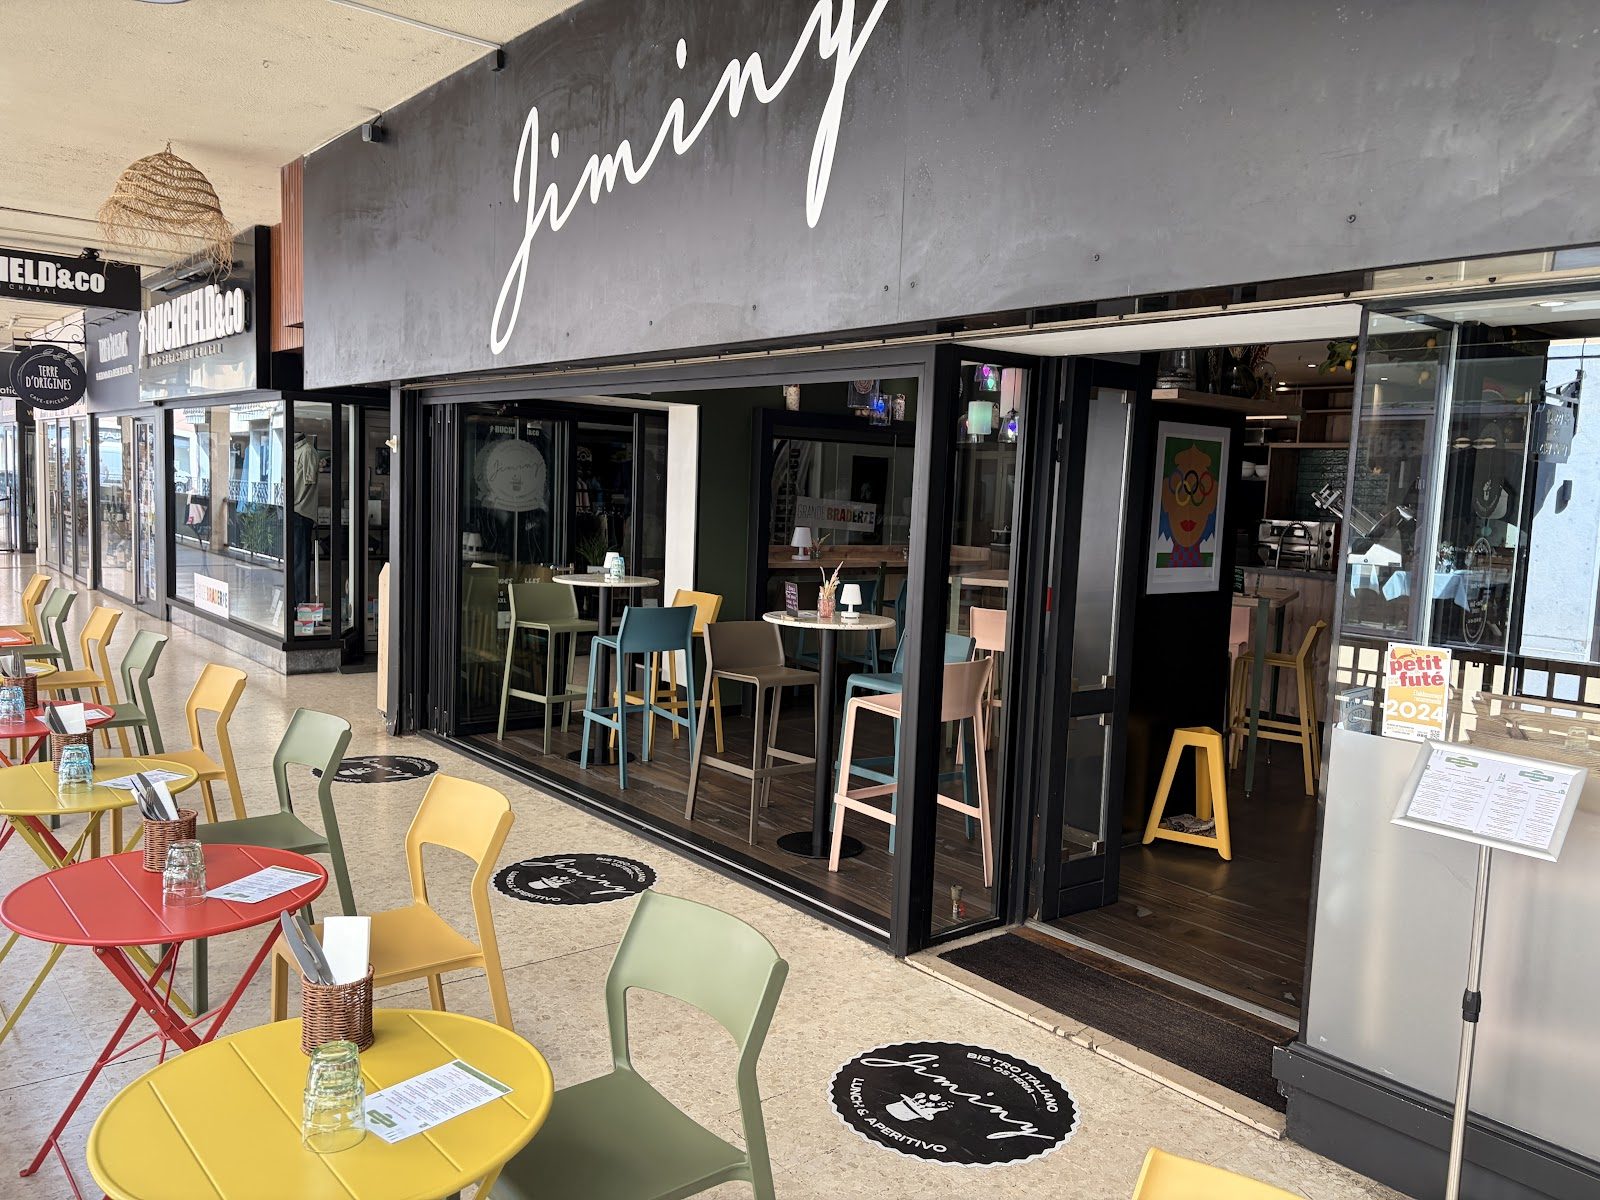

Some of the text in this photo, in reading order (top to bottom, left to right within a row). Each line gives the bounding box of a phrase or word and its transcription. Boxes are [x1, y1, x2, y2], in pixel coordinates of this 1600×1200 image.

[490, 0, 889, 355] Jiminy
[9, 284, 57, 294] CHABAL
[147, 283, 244, 355] RUCKFIELD&CO
[25, 375, 72, 391] D'ORIGINES
[38, 365, 59, 378] TERRE
[1389, 654, 1442, 675] petit
[1399, 671, 1444, 687] futé
[1386, 699, 1445, 722] 2024
[519, 858, 636, 895] Jiminy
[966, 1052, 1059, 1114] BISTRO ITALIANO
[992, 1066, 1035, 1095] OSTERIA
[859, 1053, 1055, 1140] Jiminy
[849, 1077, 948, 1153] LUNCH & APERITIVO
